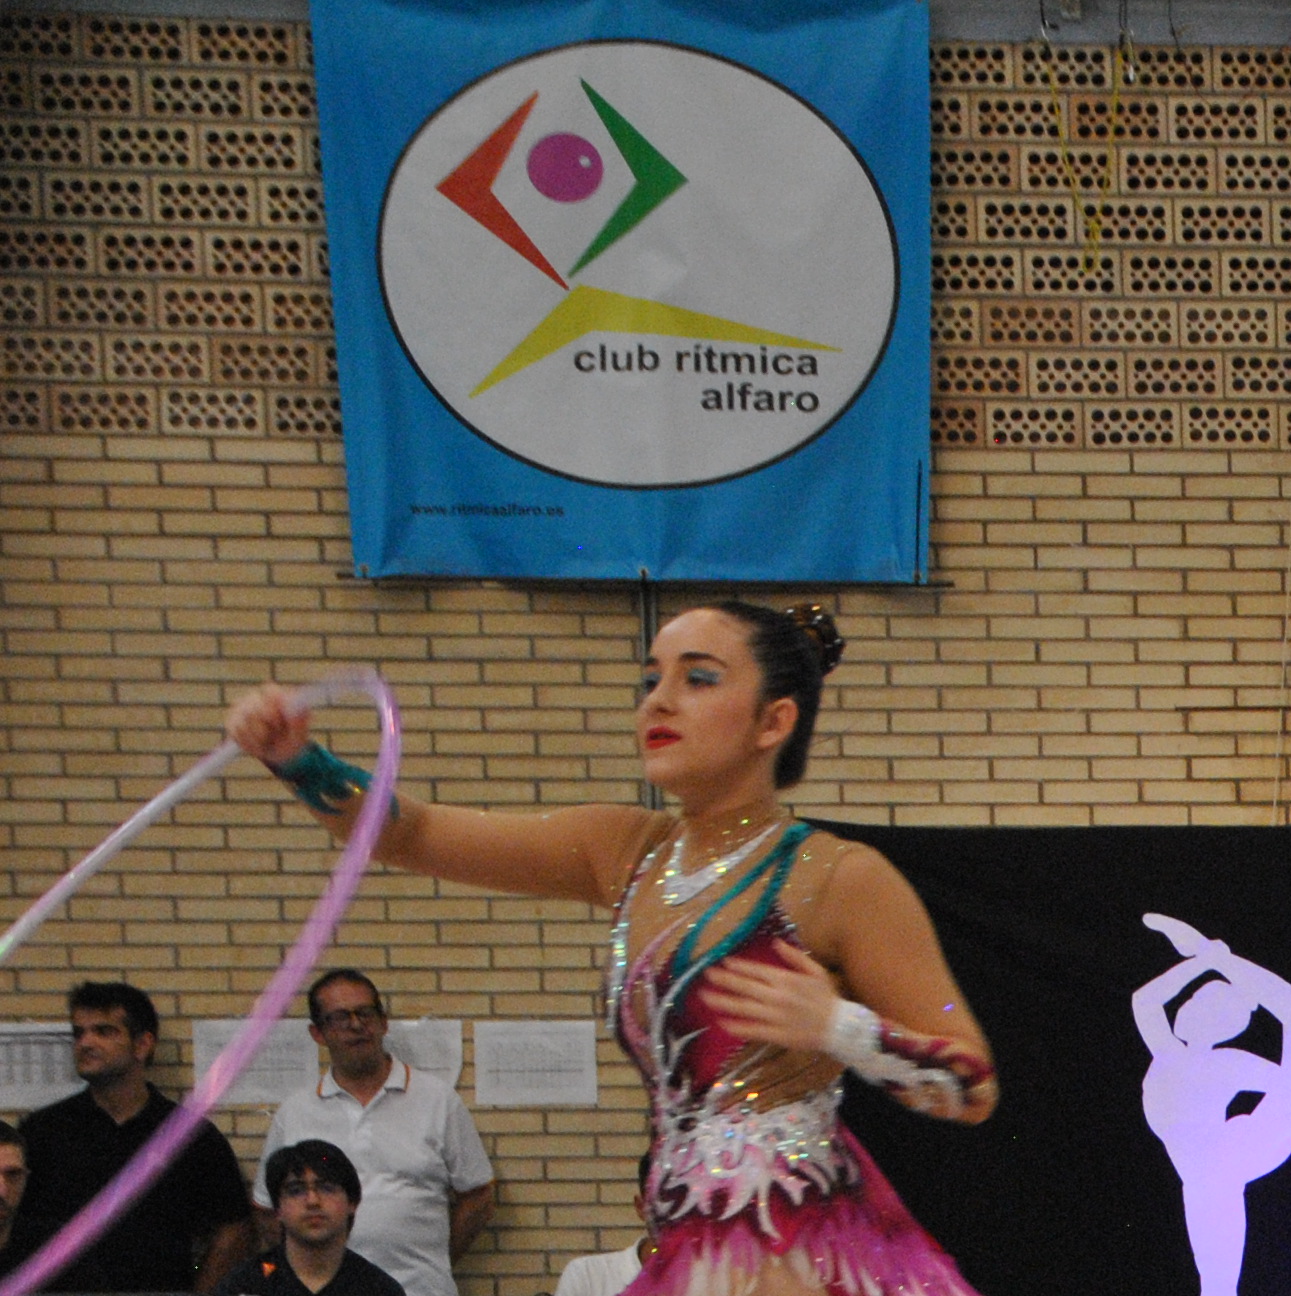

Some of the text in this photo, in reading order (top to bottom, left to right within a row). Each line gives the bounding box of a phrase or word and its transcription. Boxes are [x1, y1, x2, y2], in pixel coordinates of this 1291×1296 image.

[573, 343, 819, 376] club ritmica
[701, 381, 820, 413] alfaro
